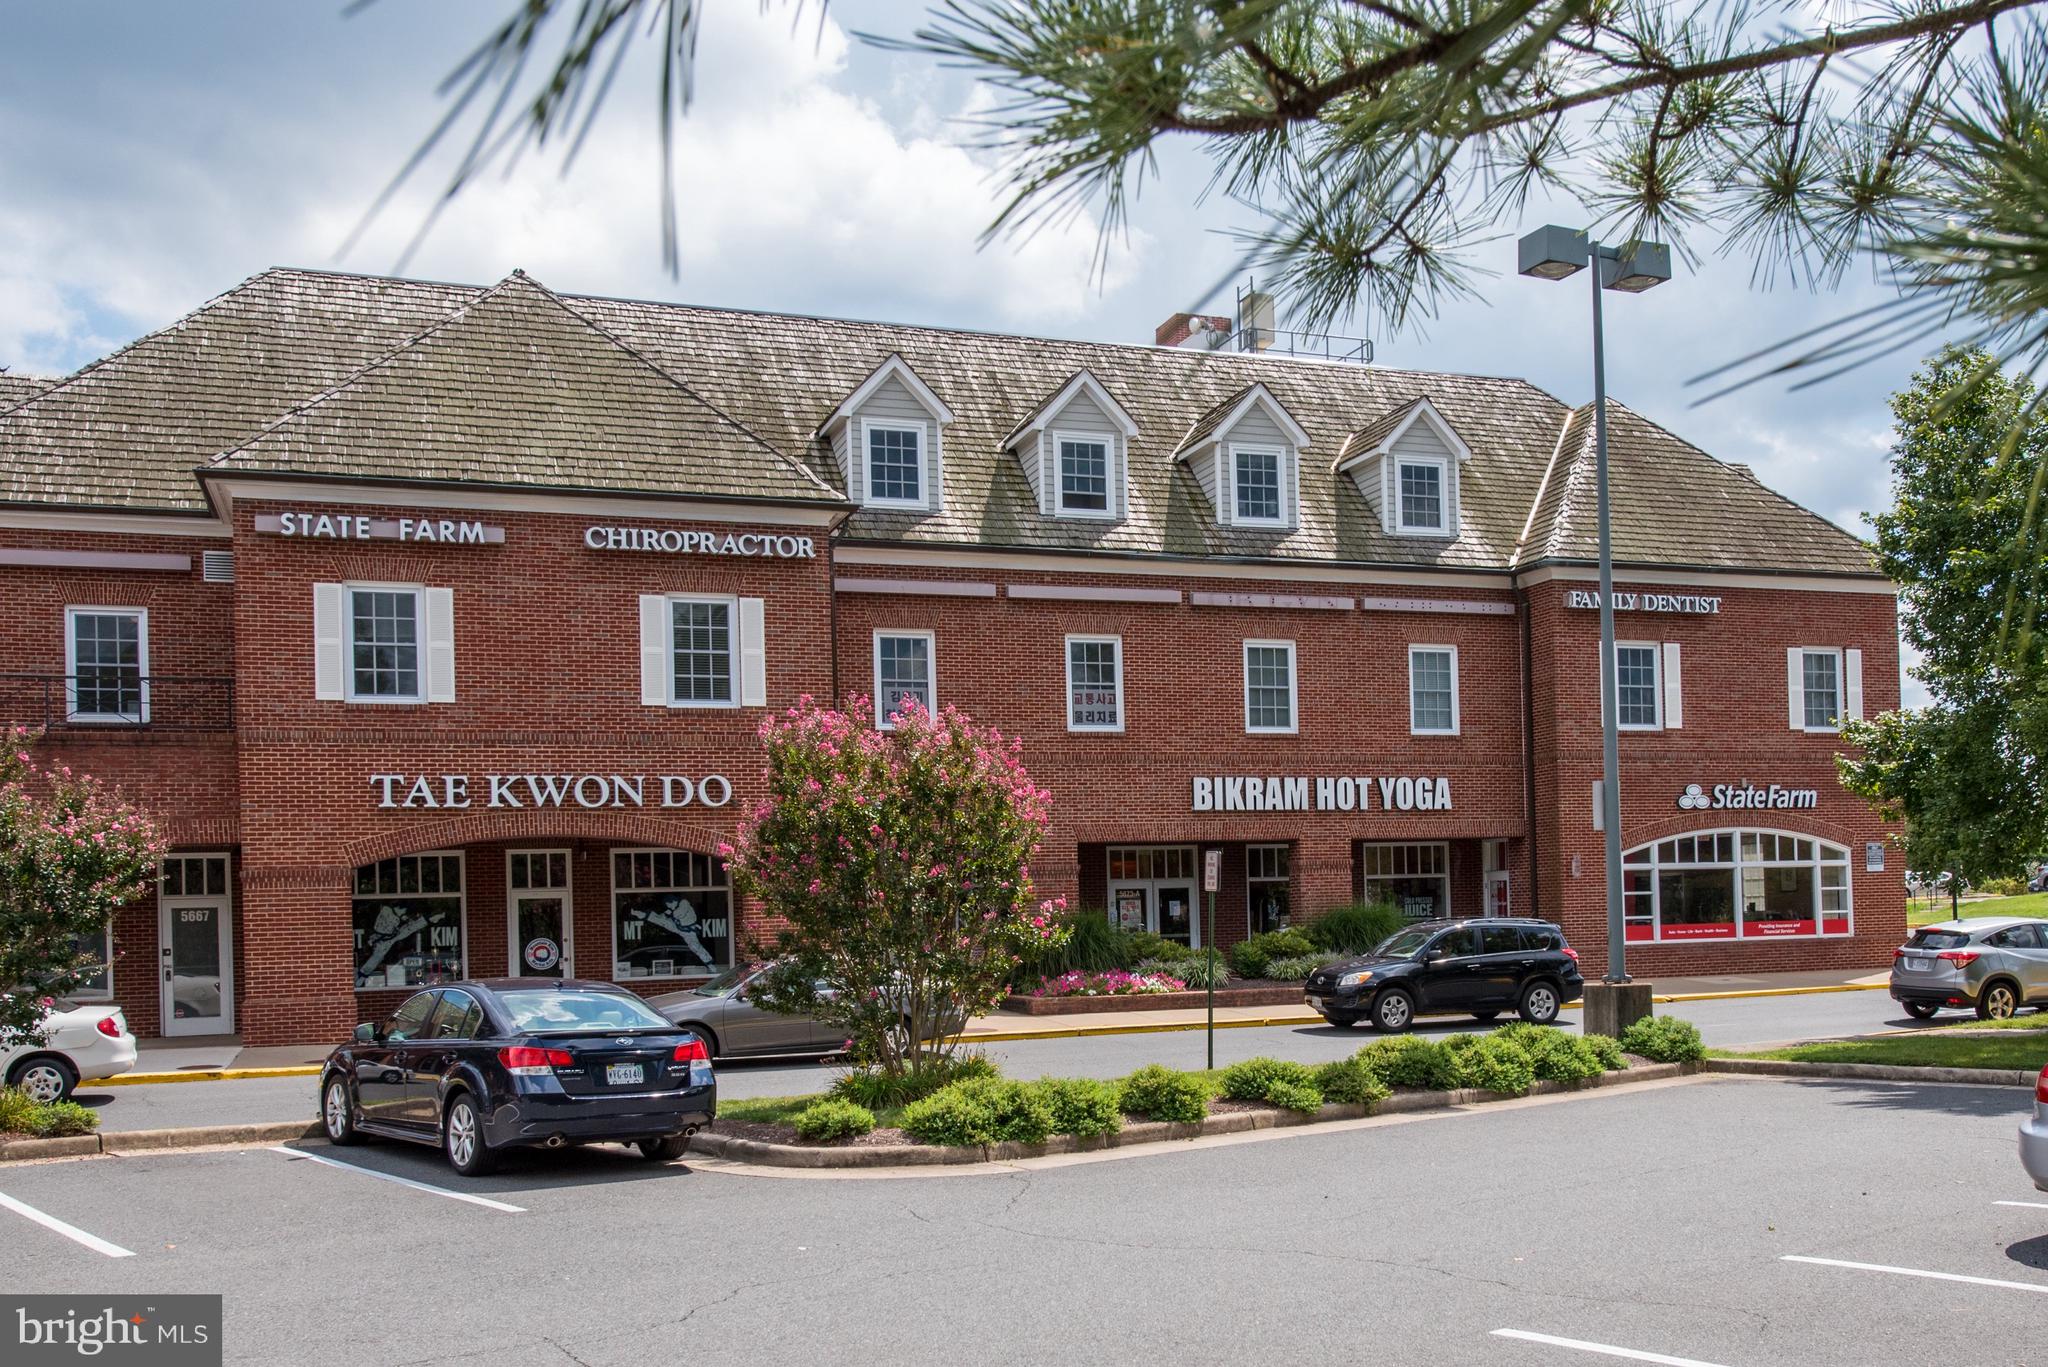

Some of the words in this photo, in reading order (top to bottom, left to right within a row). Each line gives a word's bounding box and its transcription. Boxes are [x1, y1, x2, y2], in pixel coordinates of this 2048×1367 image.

[280, 512, 370, 539] STATE
[399, 518, 486, 543] FARM
[585, 526, 817, 559] CHIROPRACTOR
[1643, 594, 1722, 613] DENTIST
[369, 774, 472, 809] TAE
[486, 774, 645, 809] KWON
[660, 774, 733, 808] DO
[1192, 776, 1309, 811] BIKRAM
[1316, 776, 1372, 811] HOT
[1379, 776, 1453, 811] YOGA
[180, 910, 210, 922] 5667
[1404, 903, 1433, 916] JUICE
[431, 926, 458, 947] KIM
[623, 920, 644, 940] MT
[702, 918, 727, 938] KIM
